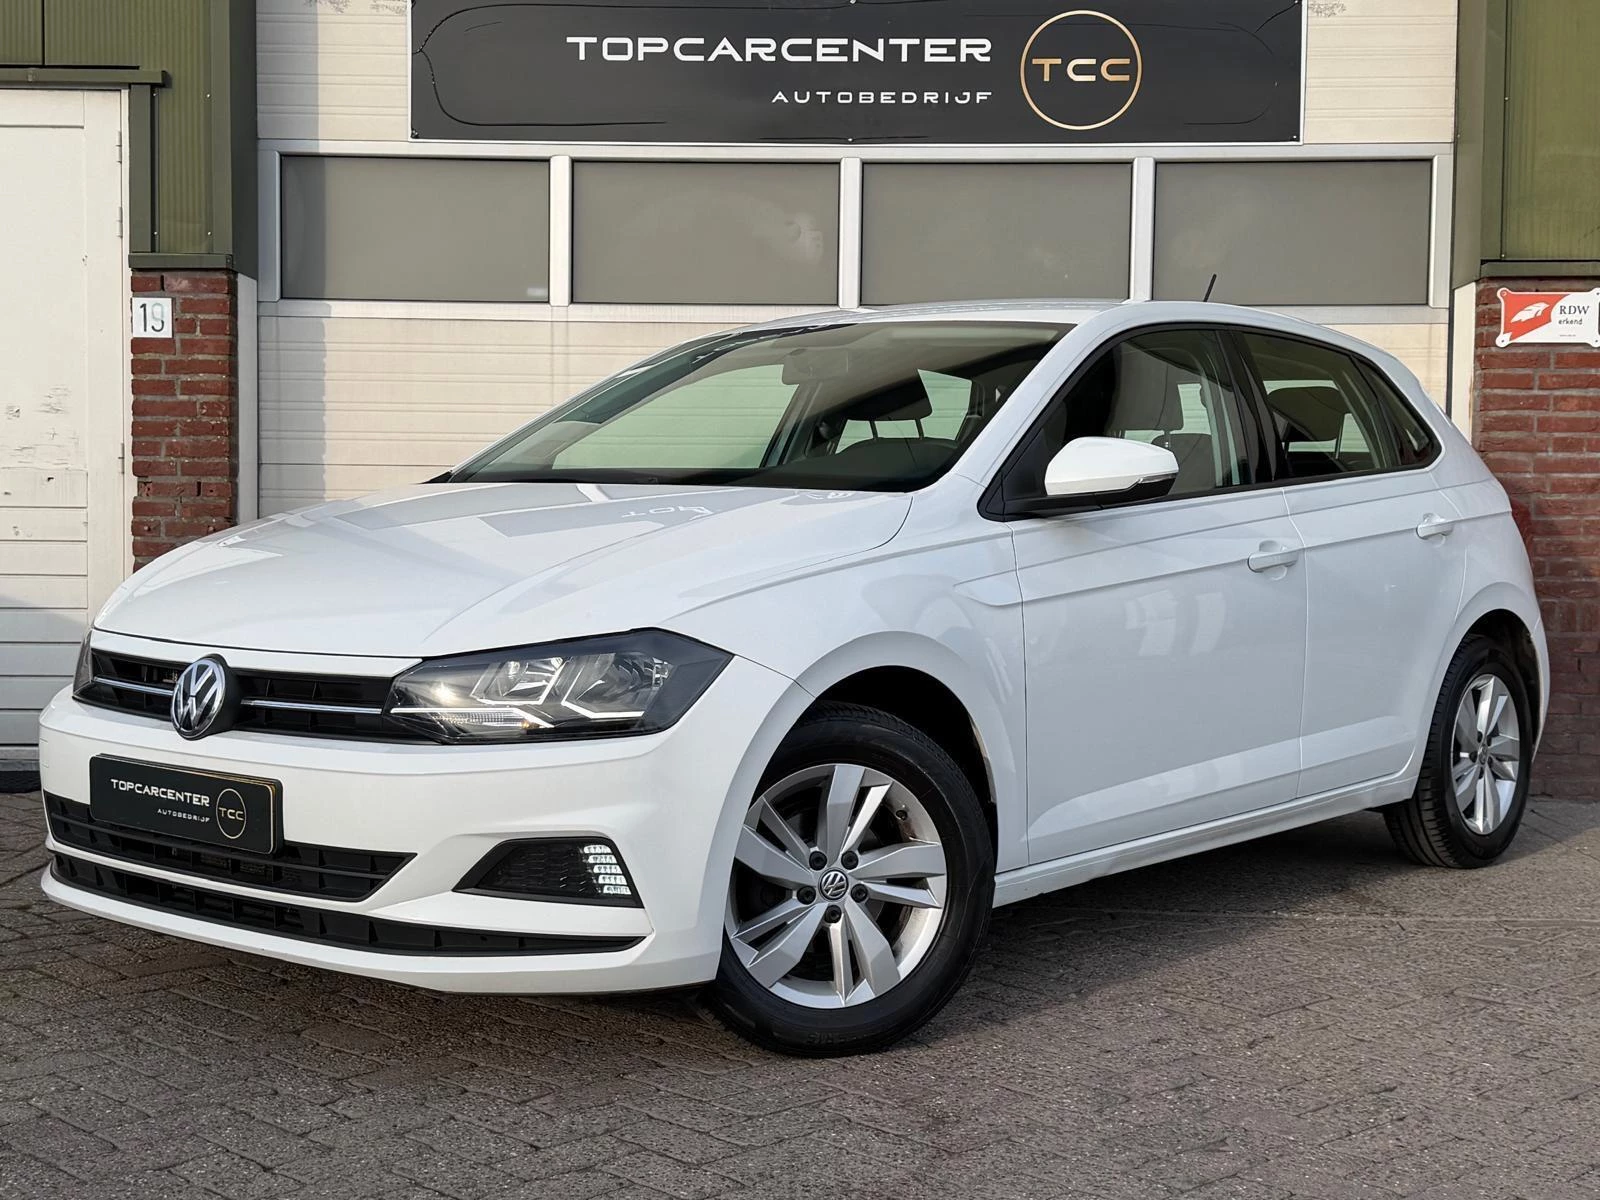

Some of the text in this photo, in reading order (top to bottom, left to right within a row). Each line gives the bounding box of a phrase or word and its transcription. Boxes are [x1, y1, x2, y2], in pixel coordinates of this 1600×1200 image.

[566, 37, 991, 62] TOPCARCENTER
[1032, 58, 1131, 82] TCC
[772, 91, 992, 104] AUTOBEDRIJF
[140, 303, 164, 332] 19
[1559, 305, 1590, 315] RDW
[111, 778, 210, 807] TOPCARCENTER
[157, 808, 210, 823] AUTOBEDRIJF
[218, 807, 244, 821] TCC
